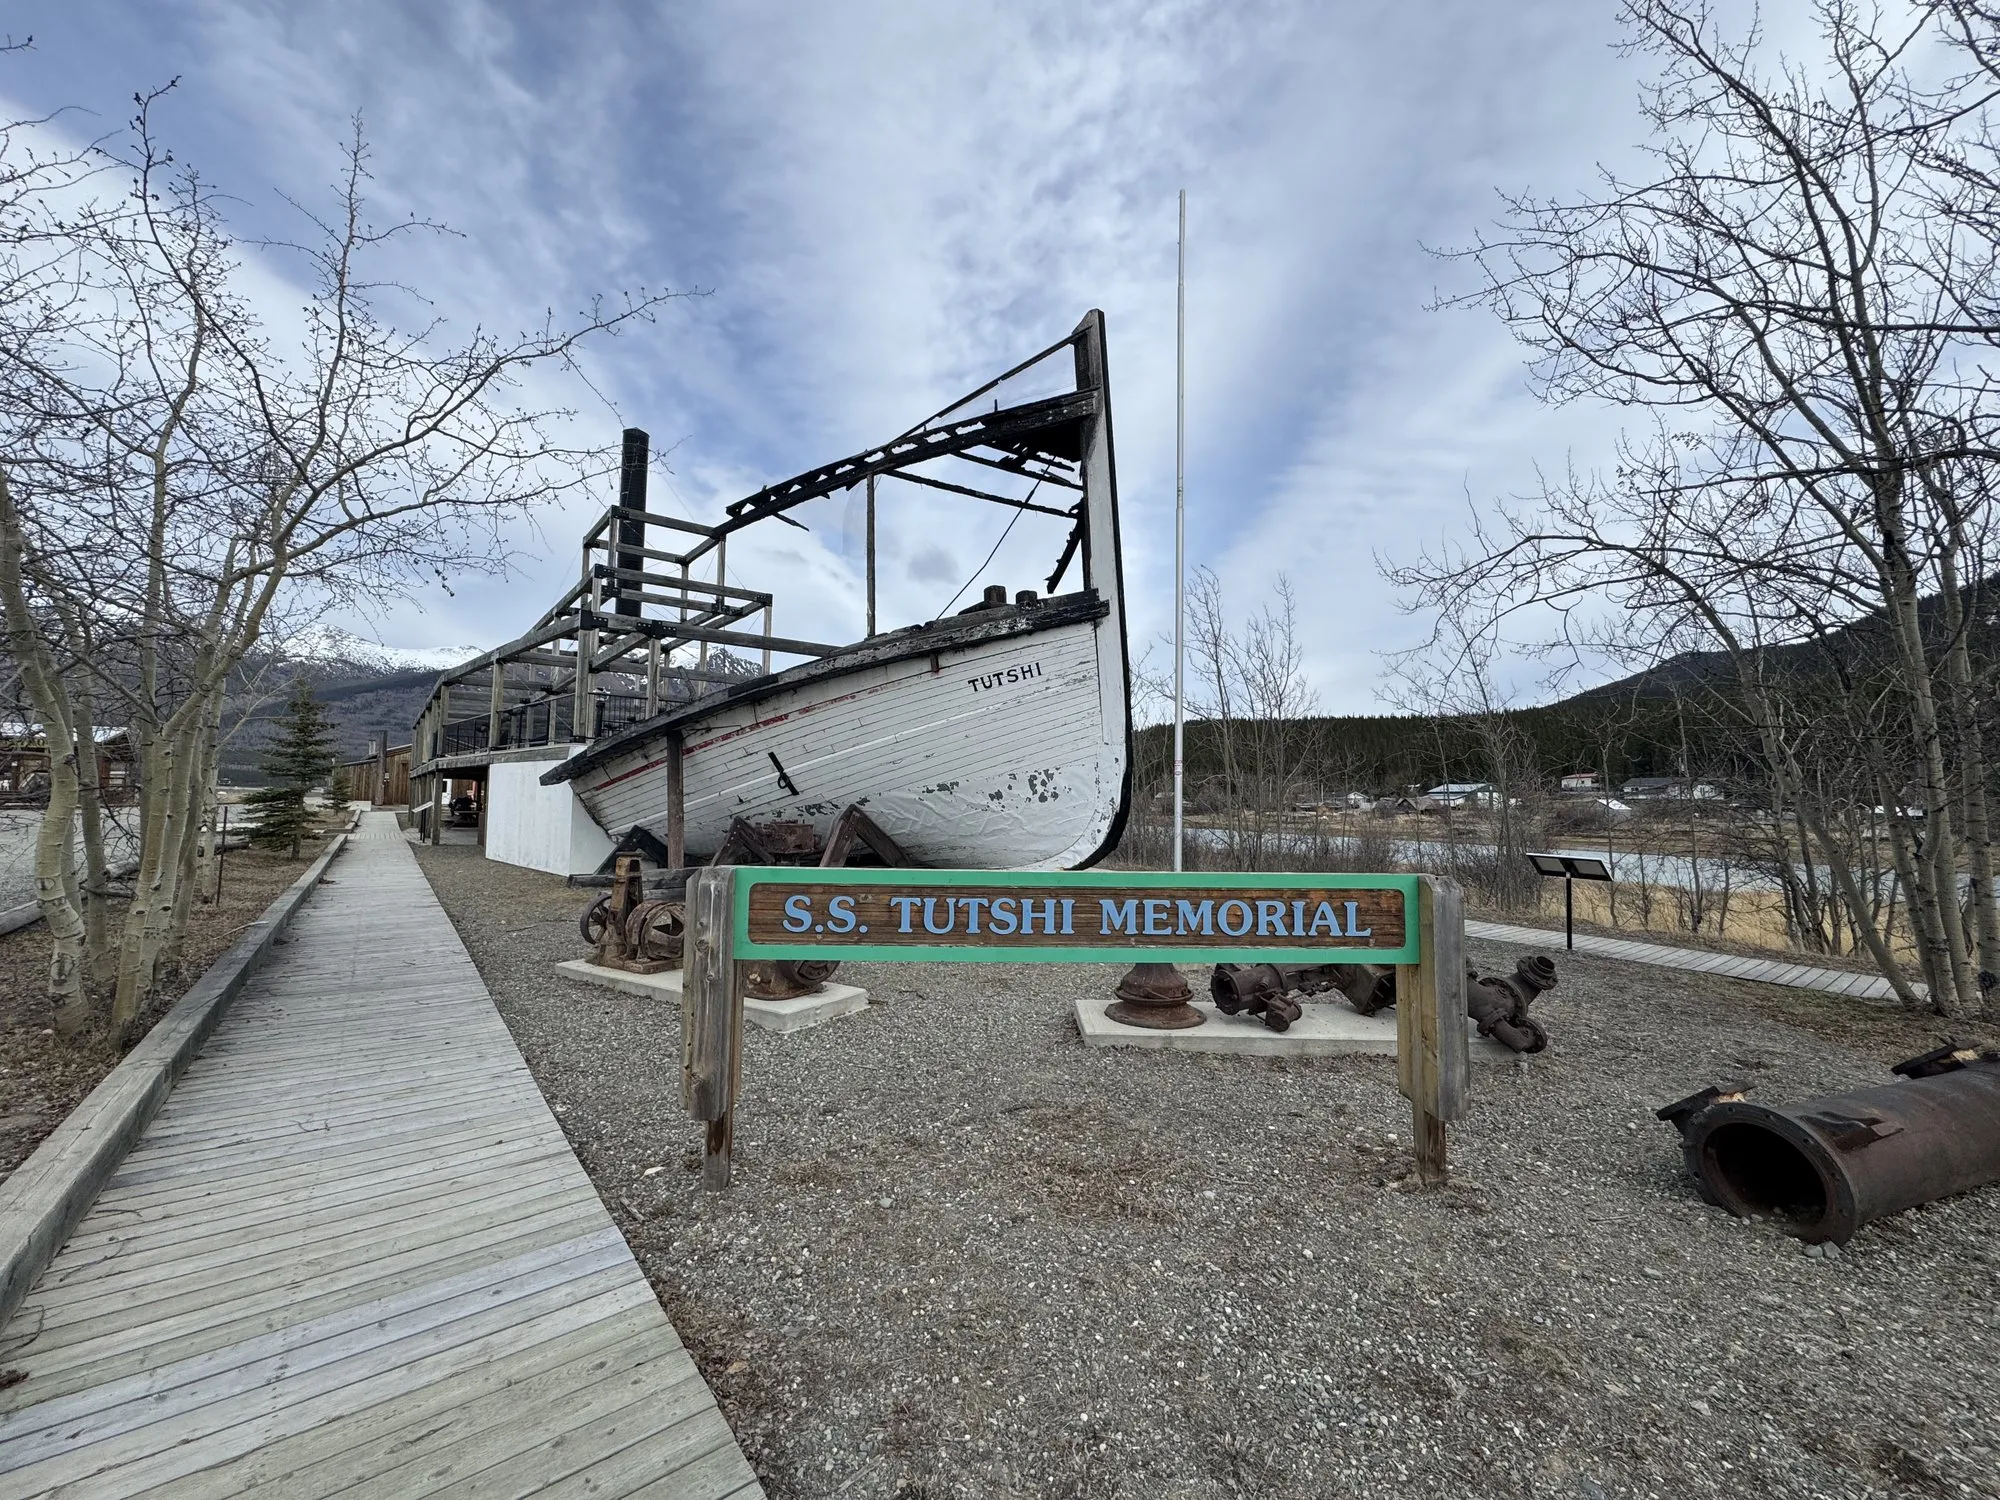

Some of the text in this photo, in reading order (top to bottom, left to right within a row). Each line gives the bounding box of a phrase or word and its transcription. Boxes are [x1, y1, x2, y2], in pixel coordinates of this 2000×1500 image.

[967, 662, 1042, 692] TUTSHI
[782, 894, 1371, 937] S.S. TUTSHI MEMORIAL
